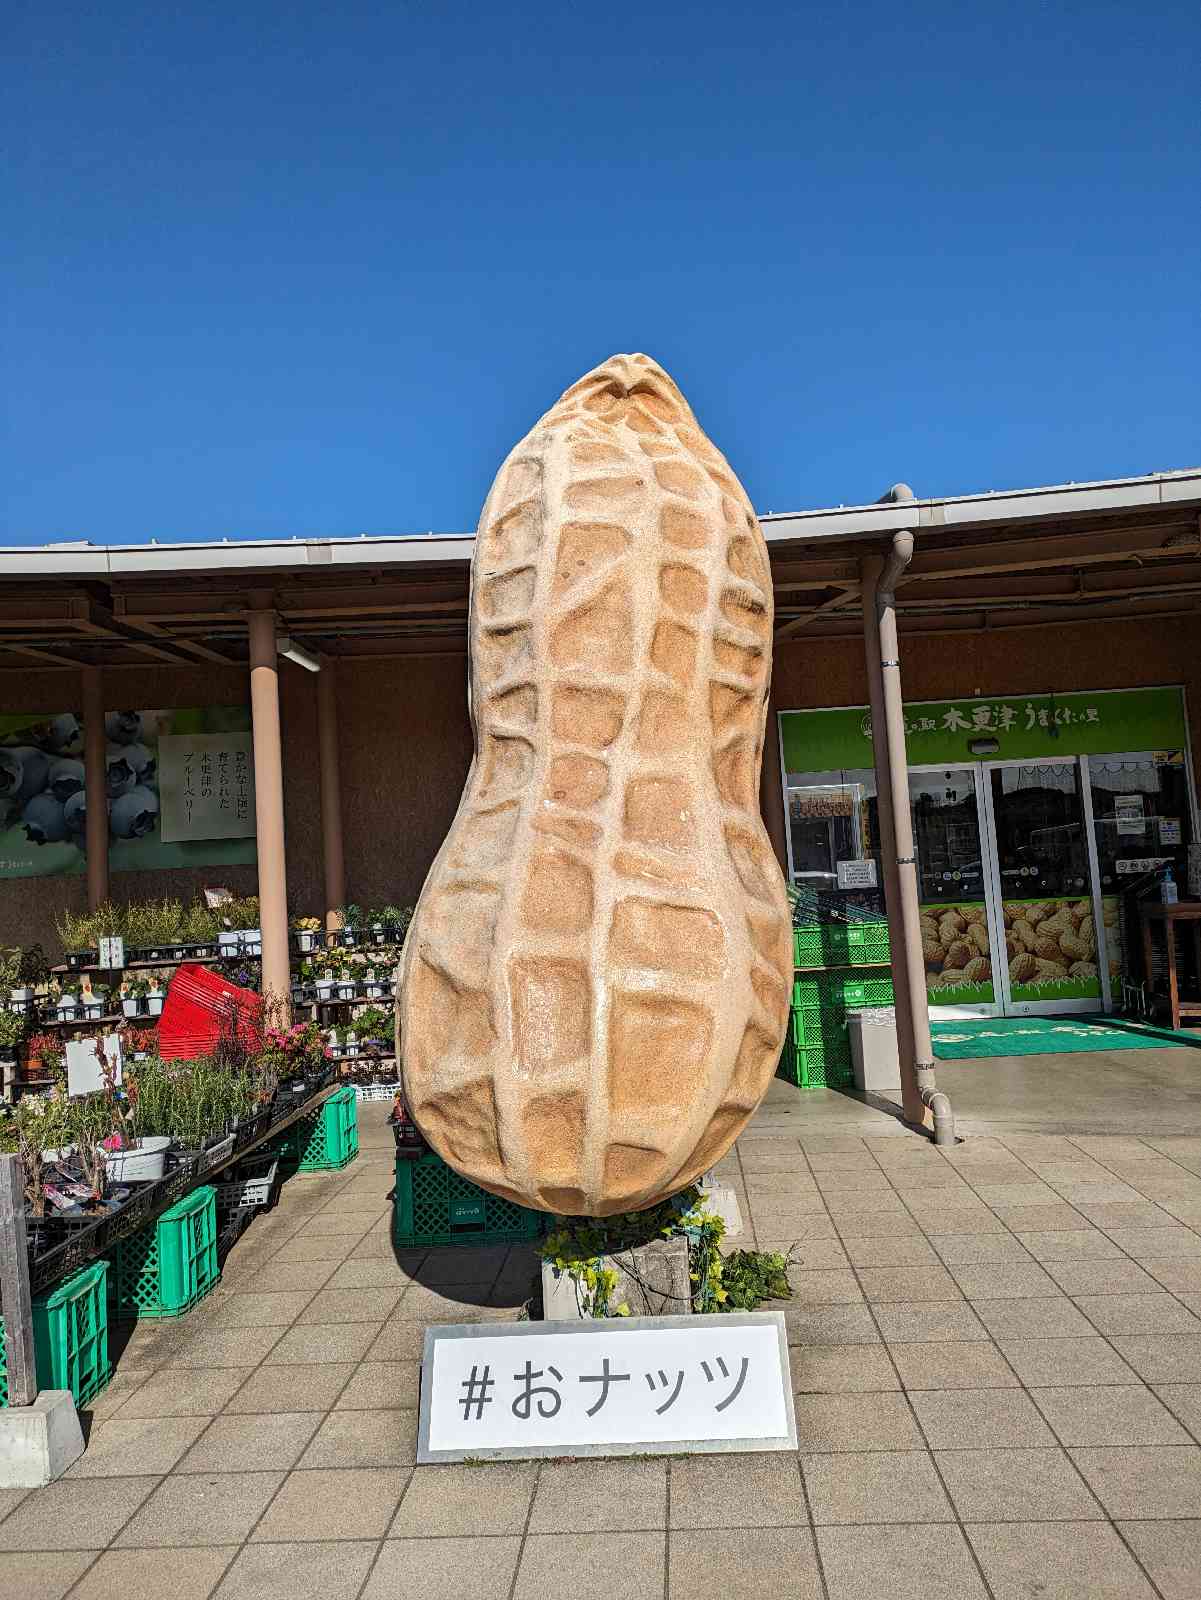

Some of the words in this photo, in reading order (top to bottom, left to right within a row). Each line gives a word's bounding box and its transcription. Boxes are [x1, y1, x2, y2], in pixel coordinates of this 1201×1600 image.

[942, 704, 1017, 733] 木更津
[458, 1356, 749, 1420] #おナッツ
